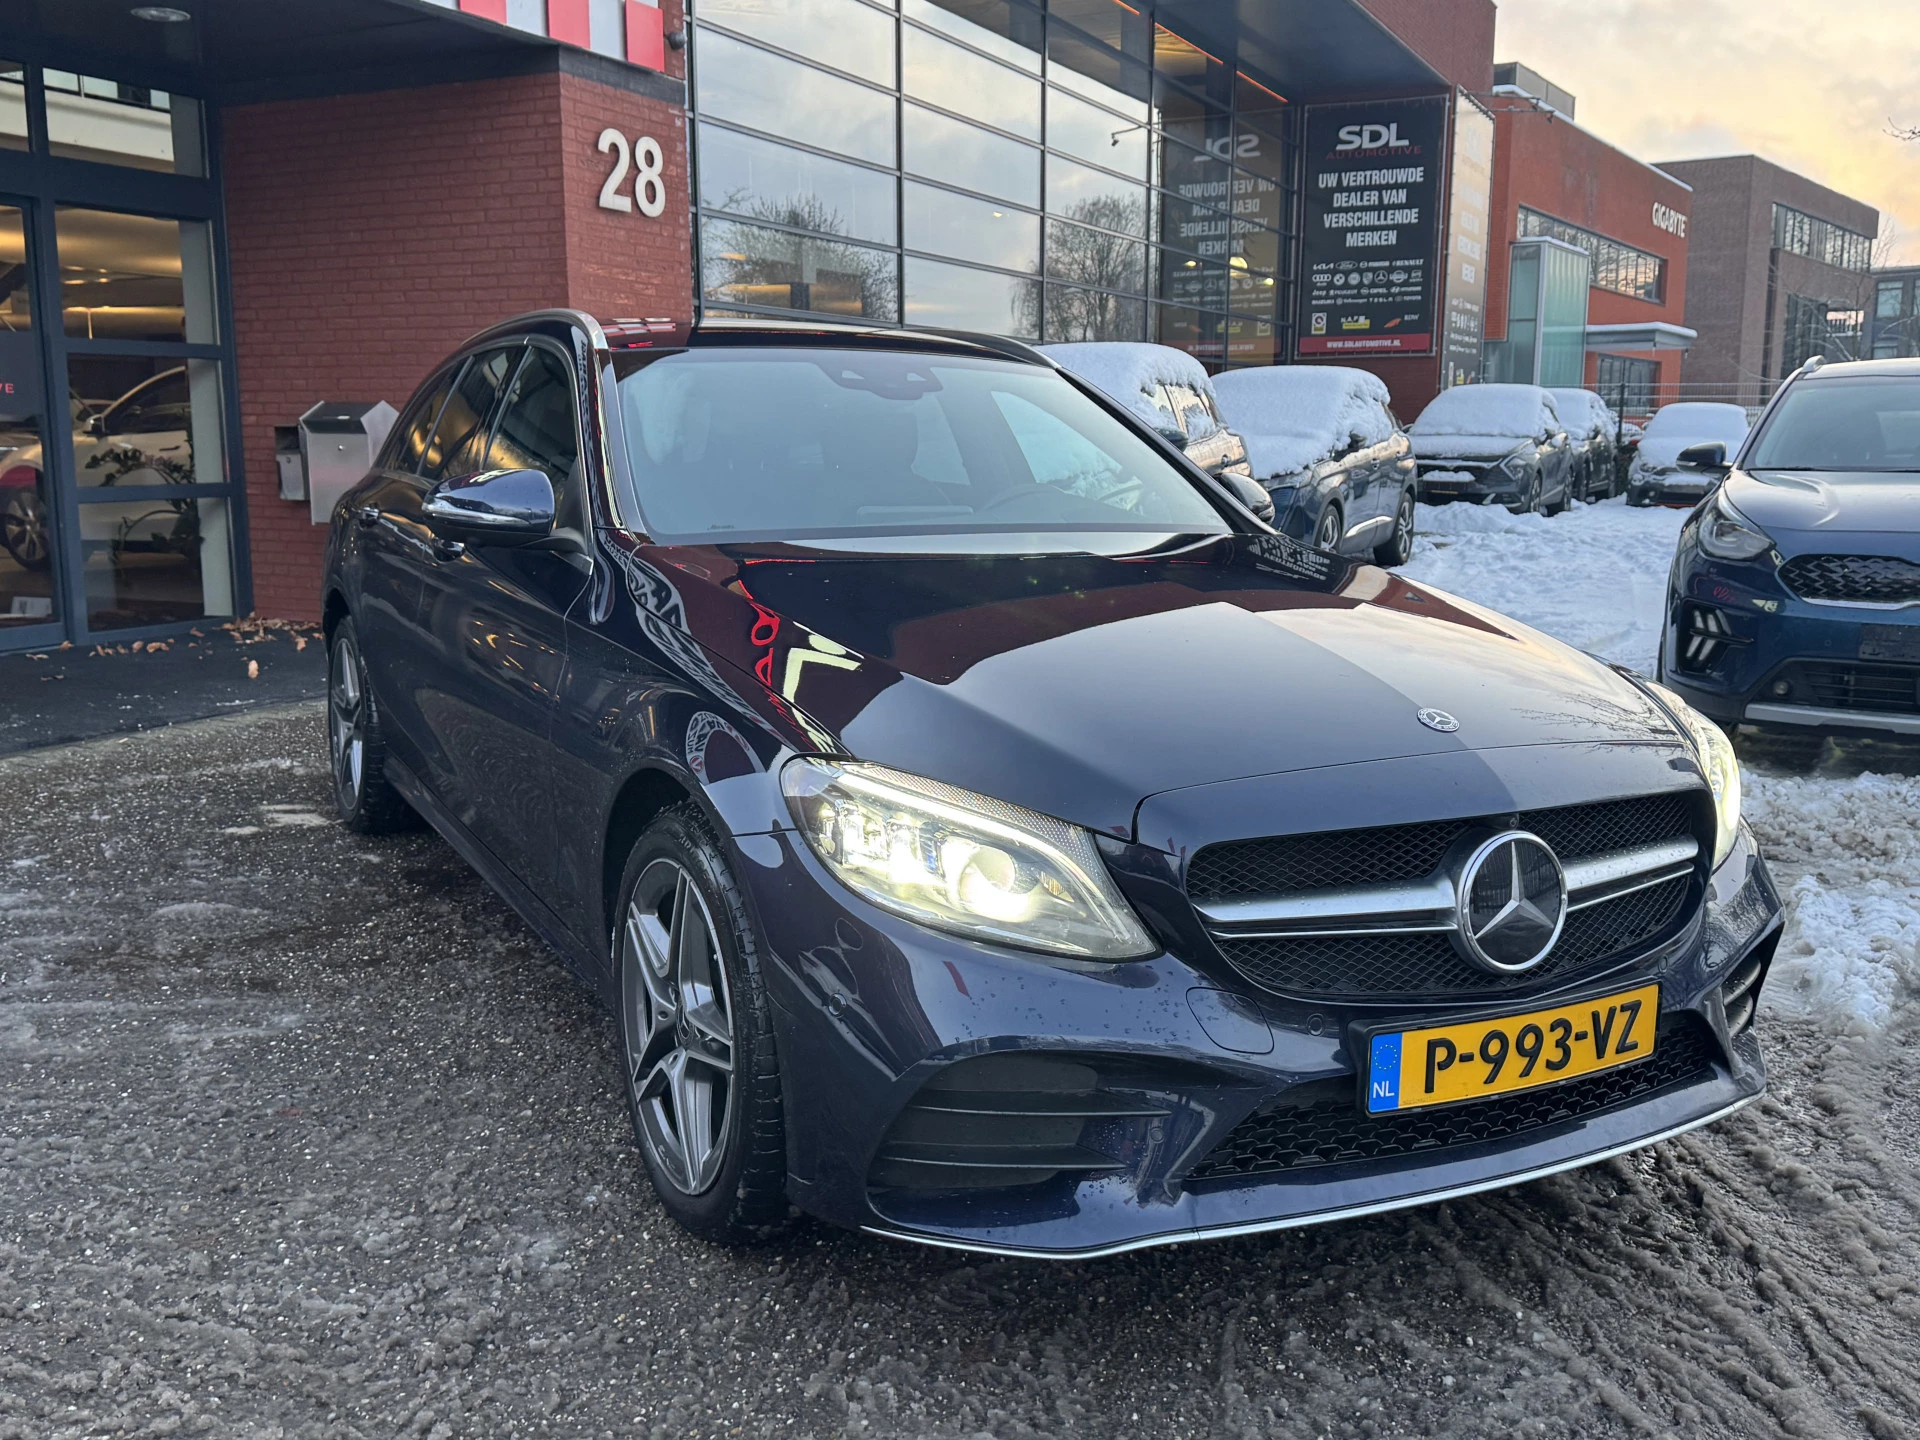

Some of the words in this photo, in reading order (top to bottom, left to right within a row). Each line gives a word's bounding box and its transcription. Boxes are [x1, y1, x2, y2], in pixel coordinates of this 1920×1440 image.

[1335, 122, 1410, 151] SDL
[1326, 146, 1421, 160] AUTOMOTIVE
[598, 128, 665, 217] 28
[1318, 172, 1338, 189] UW
[1341, 166, 1424, 188] VERTROUWDE
[1333, 190, 1379, 207] DEALER
[1381, 188, 1407, 205] VAN
[1323, 208, 1419, 229] VERSCHILLENDE
[1652, 201, 1688, 238] GIGABYTE
[1345, 229, 1397, 248] MERKEN
[1424, 1000, 1643, 1094] P-993-VZ
[1372, 1080, 1395, 1099] NL
